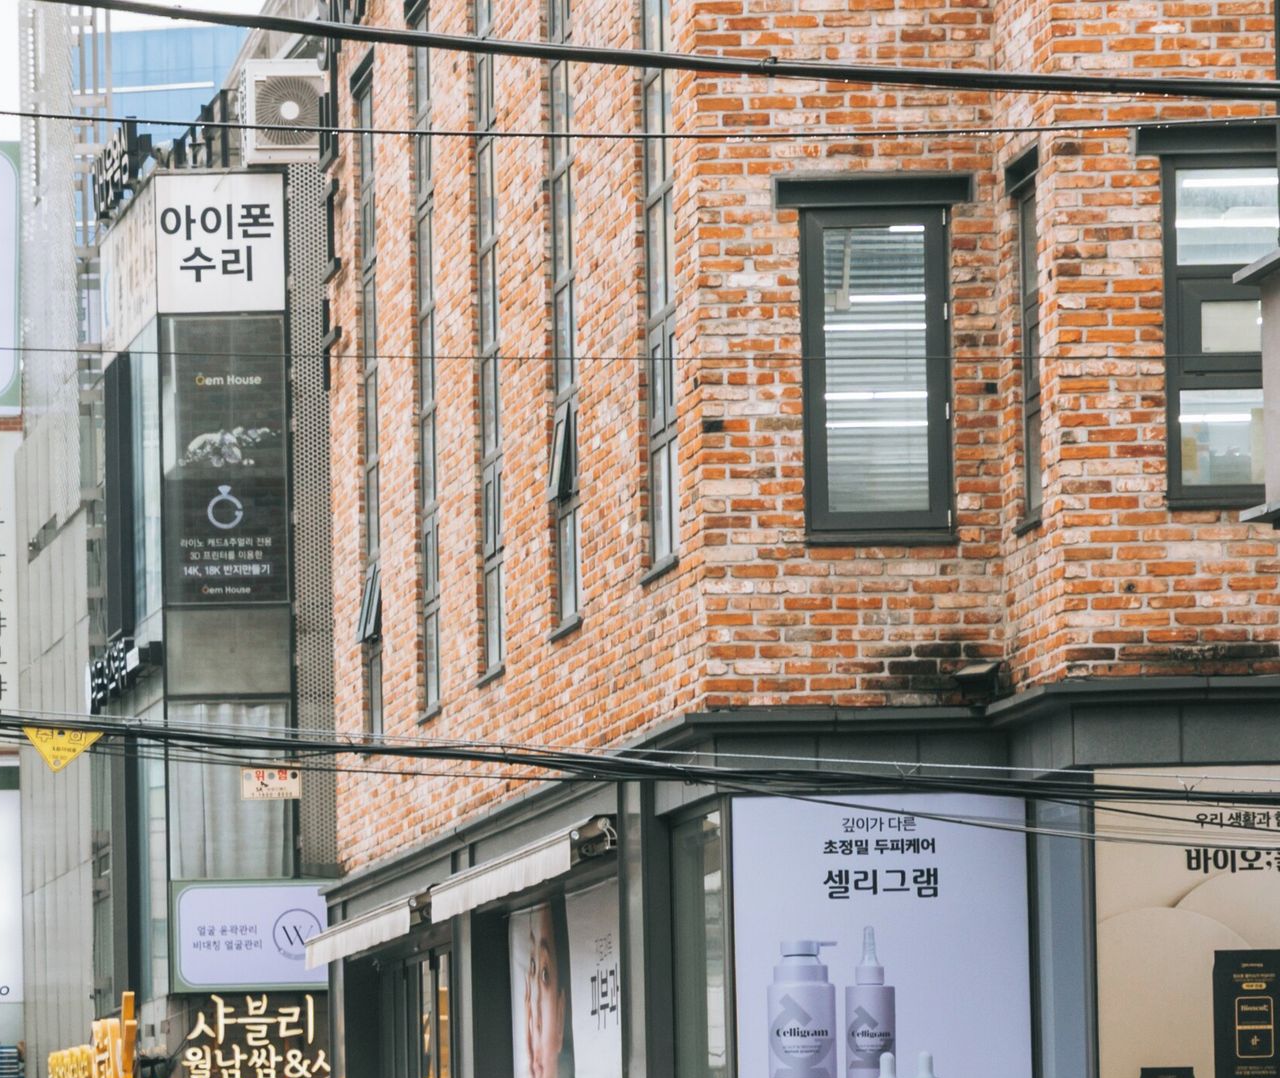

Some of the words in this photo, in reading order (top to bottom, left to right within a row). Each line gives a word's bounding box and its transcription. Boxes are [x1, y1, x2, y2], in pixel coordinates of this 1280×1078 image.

[160, 203, 274, 241] 아이폰
[179, 245, 254, 284] 수리
[227, 375, 262, 386] House
[223, 565, 270, 576] 반지만들기
[255, 769, 288, 781] 위험
[842, 817, 884, 832] 깊이가
[888, 816, 917, 831] 다른
[1196, 812, 1223, 828] 우리
[1227, 810, 1271, 828] 생활과
[823, 839, 869, 855] 초정밀
[874, 838, 936, 854] 두피케어
[823, 868, 938, 899] 셀리그램
[187, 994, 315, 1046] 샤블리
[776, 1026, 829, 1039] Celligram
[850, 1029, 891, 1039] Celligram
